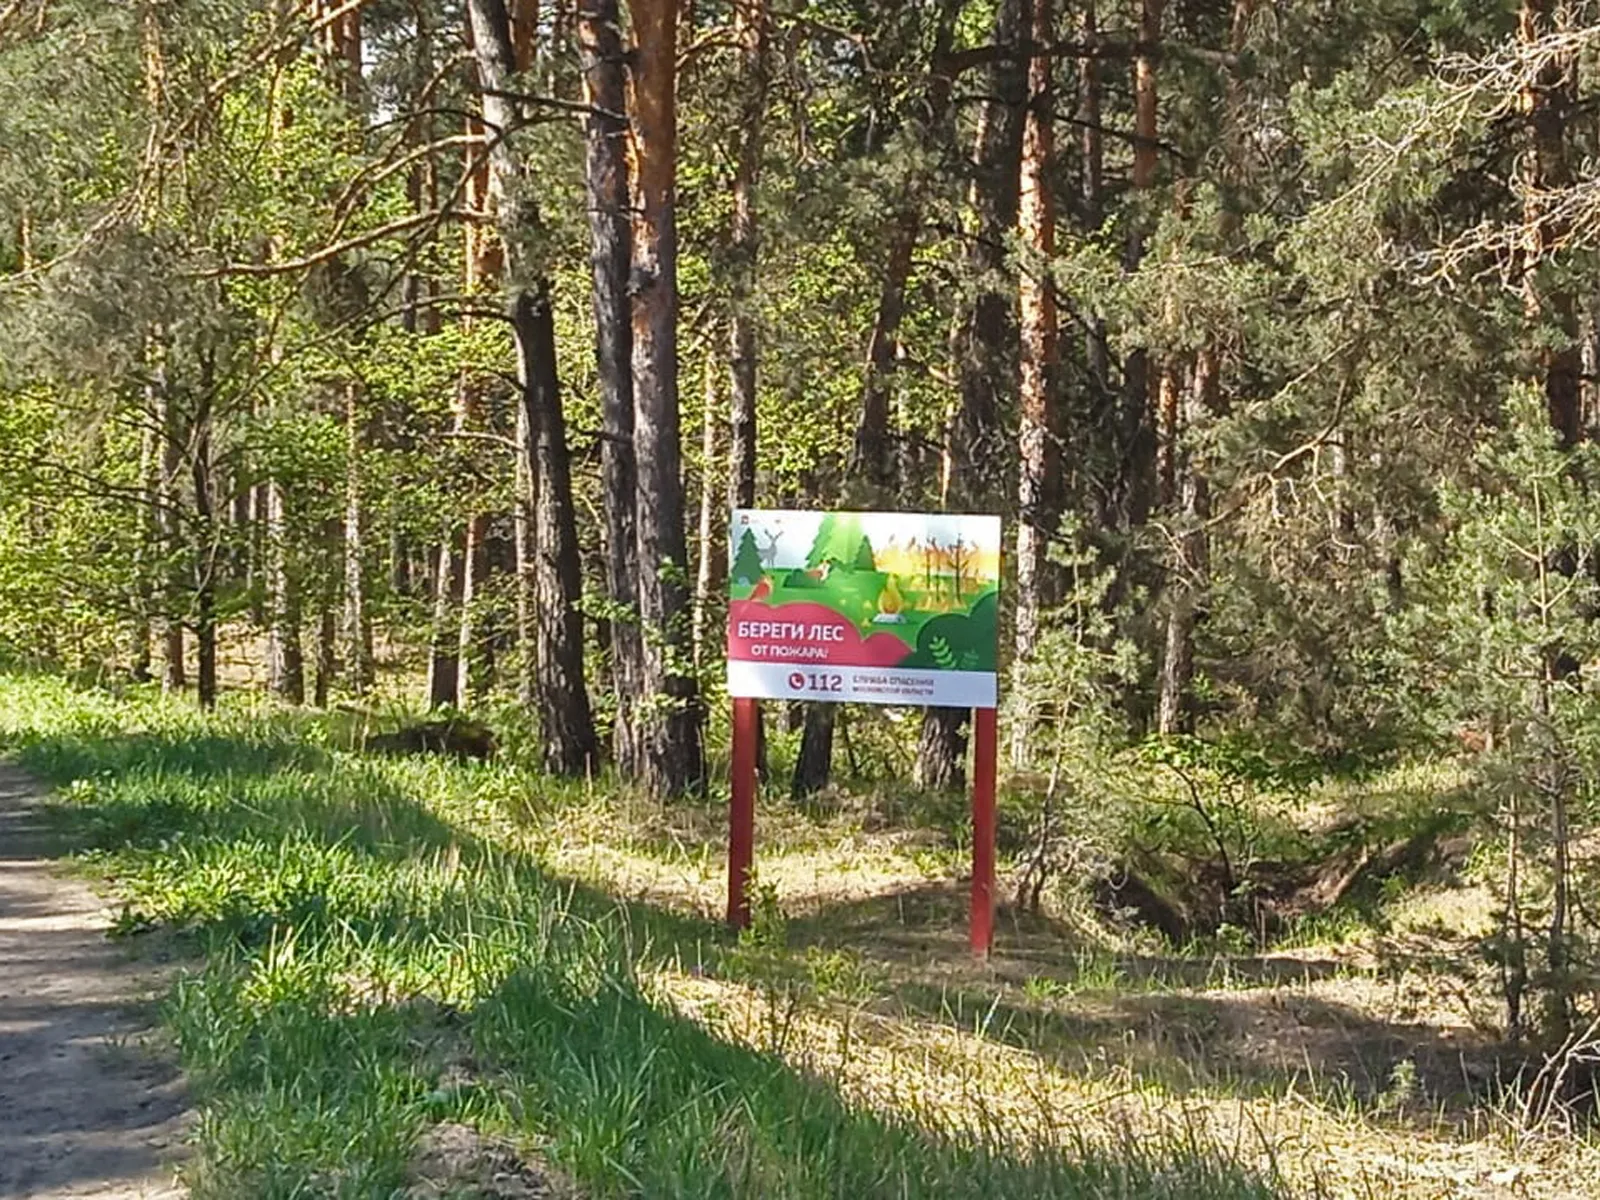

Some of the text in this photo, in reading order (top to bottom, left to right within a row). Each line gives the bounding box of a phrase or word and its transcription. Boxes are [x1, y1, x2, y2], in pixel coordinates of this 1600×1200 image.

[738, 621, 844, 641] БЕРЕГИ ЛЕС
[751, 644, 829, 659] ОТ ПОЖАРА!
[808, 674, 842, 692] 112
